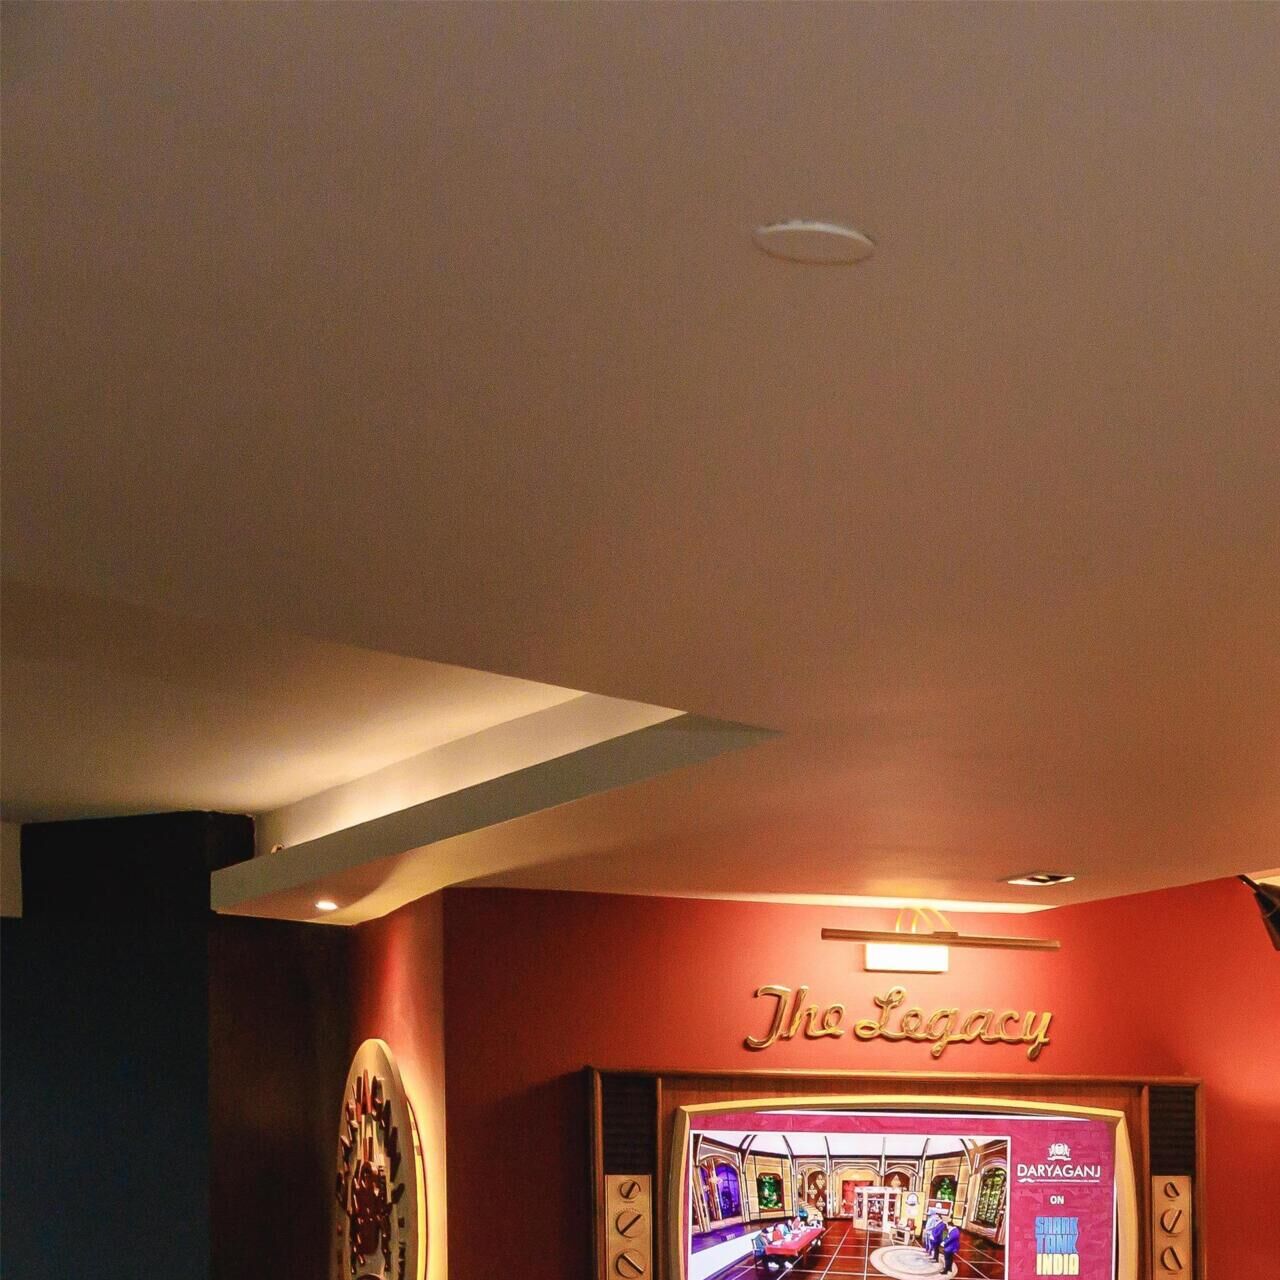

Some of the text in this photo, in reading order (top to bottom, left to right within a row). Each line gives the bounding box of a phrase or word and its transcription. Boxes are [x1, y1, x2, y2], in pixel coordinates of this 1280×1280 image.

[742, 984, 1054, 1063] The Legacy
[1017, 1164, 1101, 1178] DARYAGANJ
[1050, 1195, 1065, 1205] ON
[1035, 1216, 1079, 1235] SHARK
[1035, 1234, 1079, 1254] TANK
[1036, 1253, 1080, 1276] INDIA
